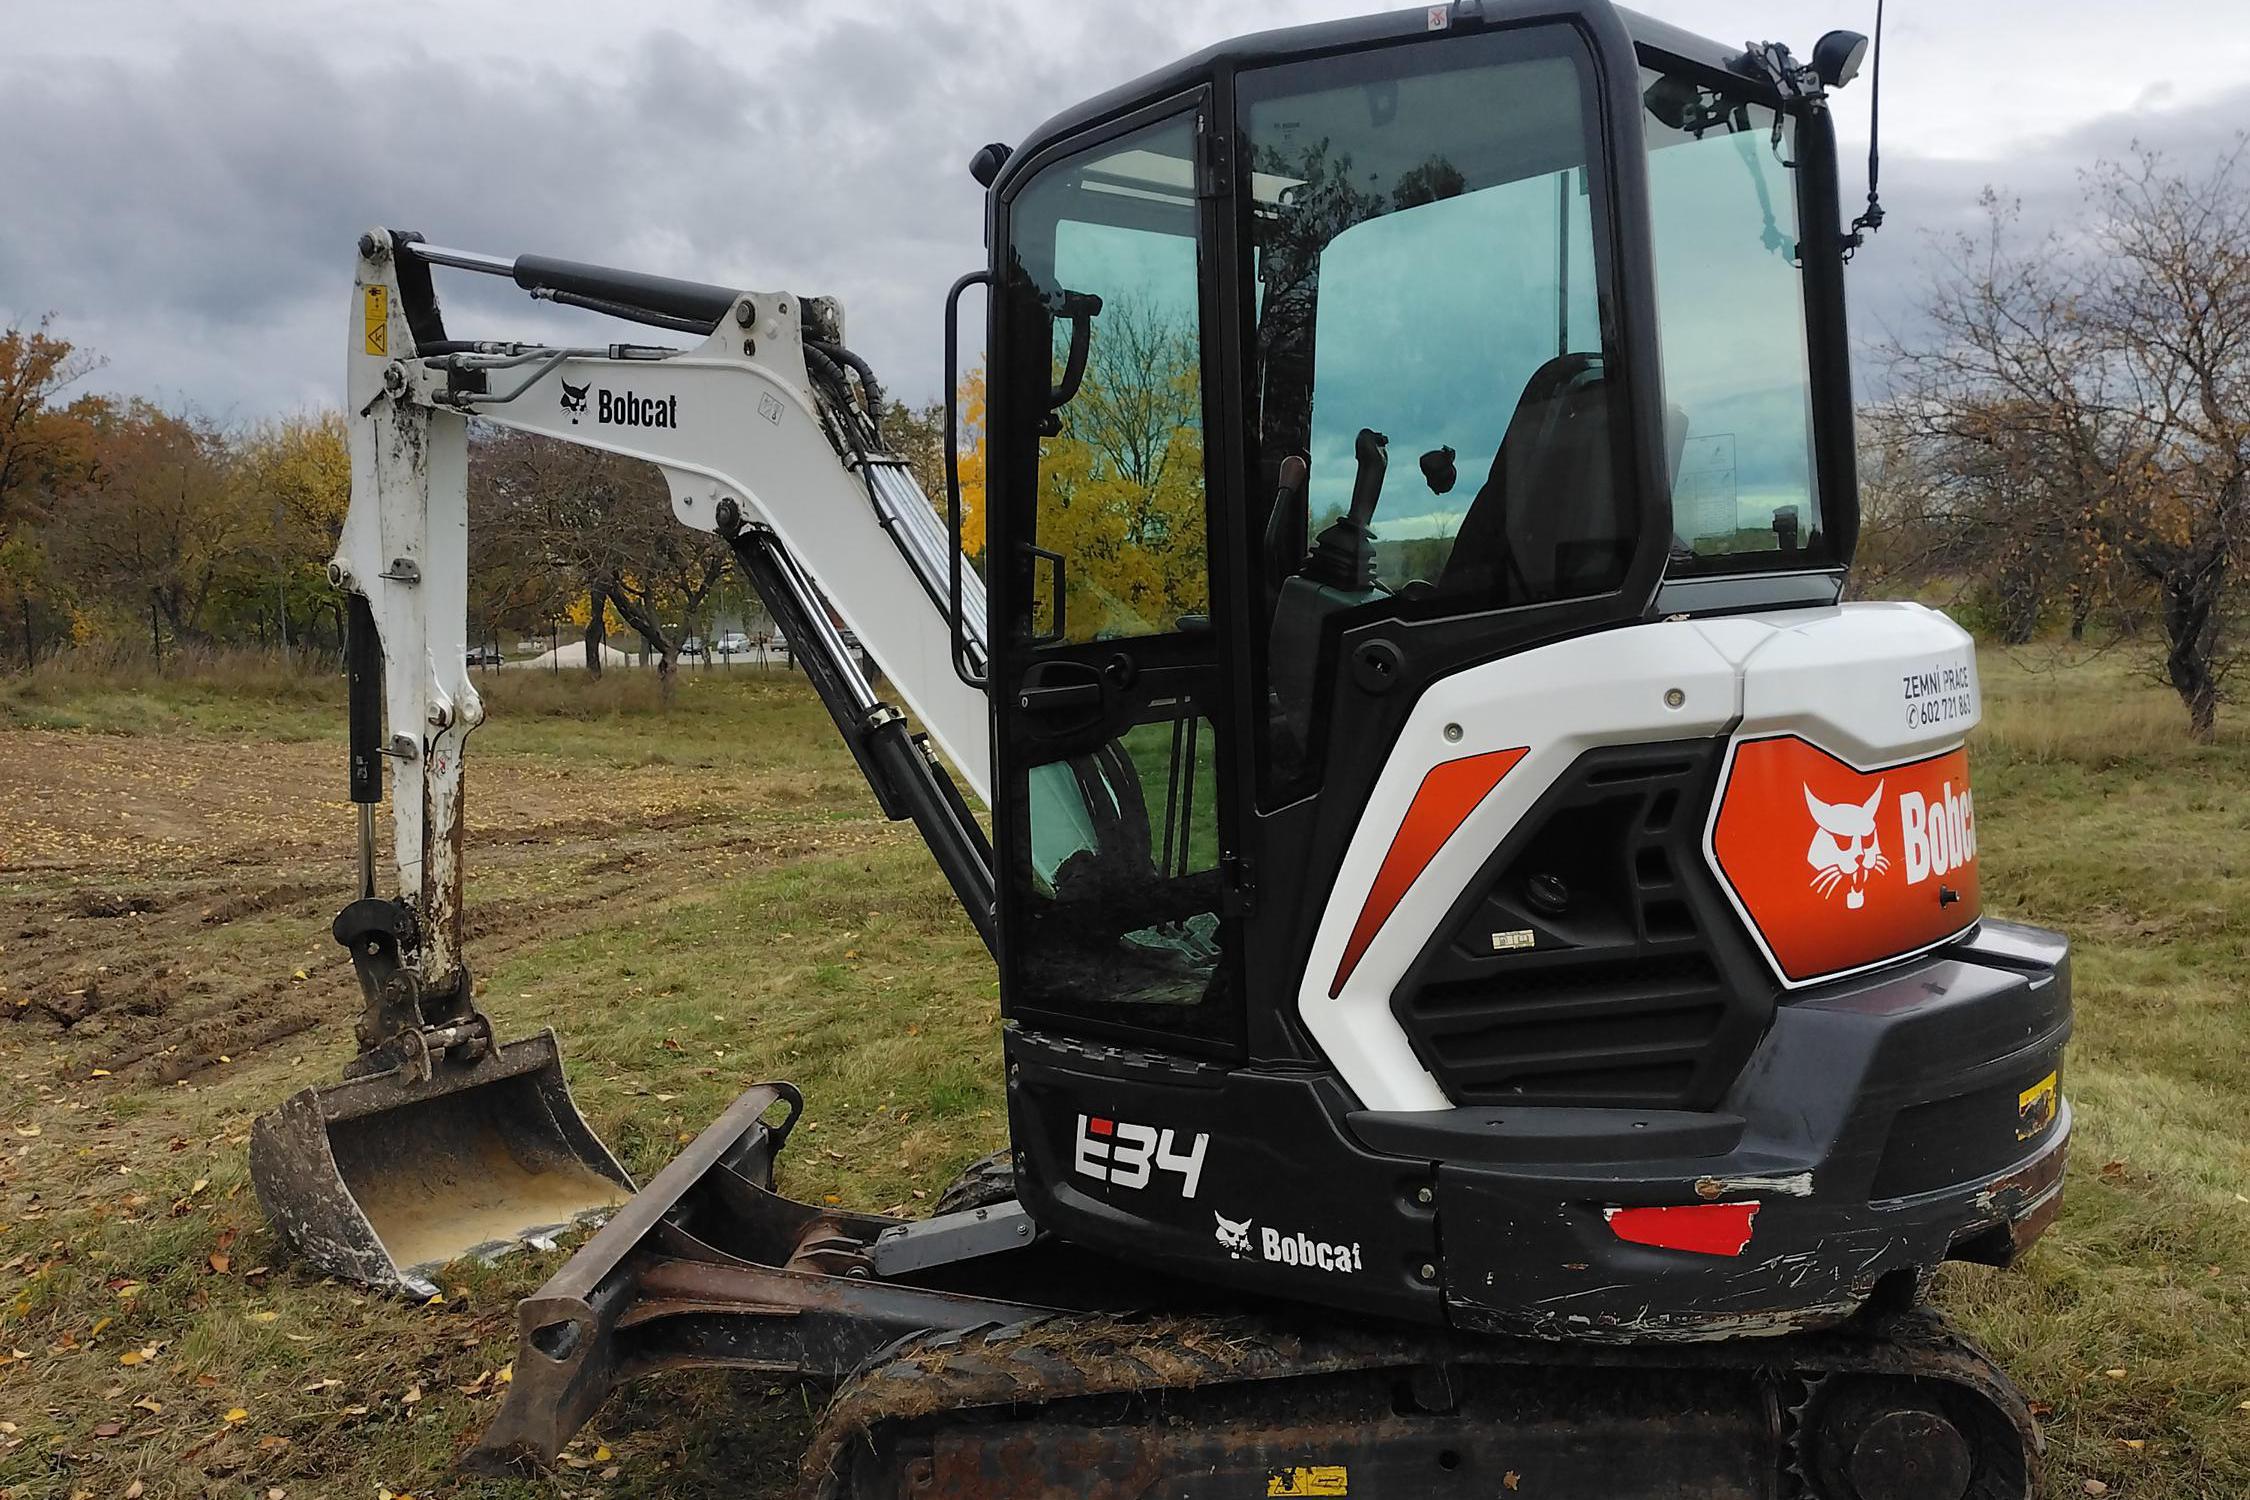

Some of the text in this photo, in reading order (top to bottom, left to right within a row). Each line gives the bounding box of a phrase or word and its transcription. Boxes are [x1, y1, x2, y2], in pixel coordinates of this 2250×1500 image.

[598, 388, 677, 429] Bobcat
[1903, 661, 1969, 699] ZEMNÍ PRÁCE
[1921, 700, 1941, 725] 602
[1942, 696, 1958, 720] 721
[1075, 1114, 1210, 1198] E34
